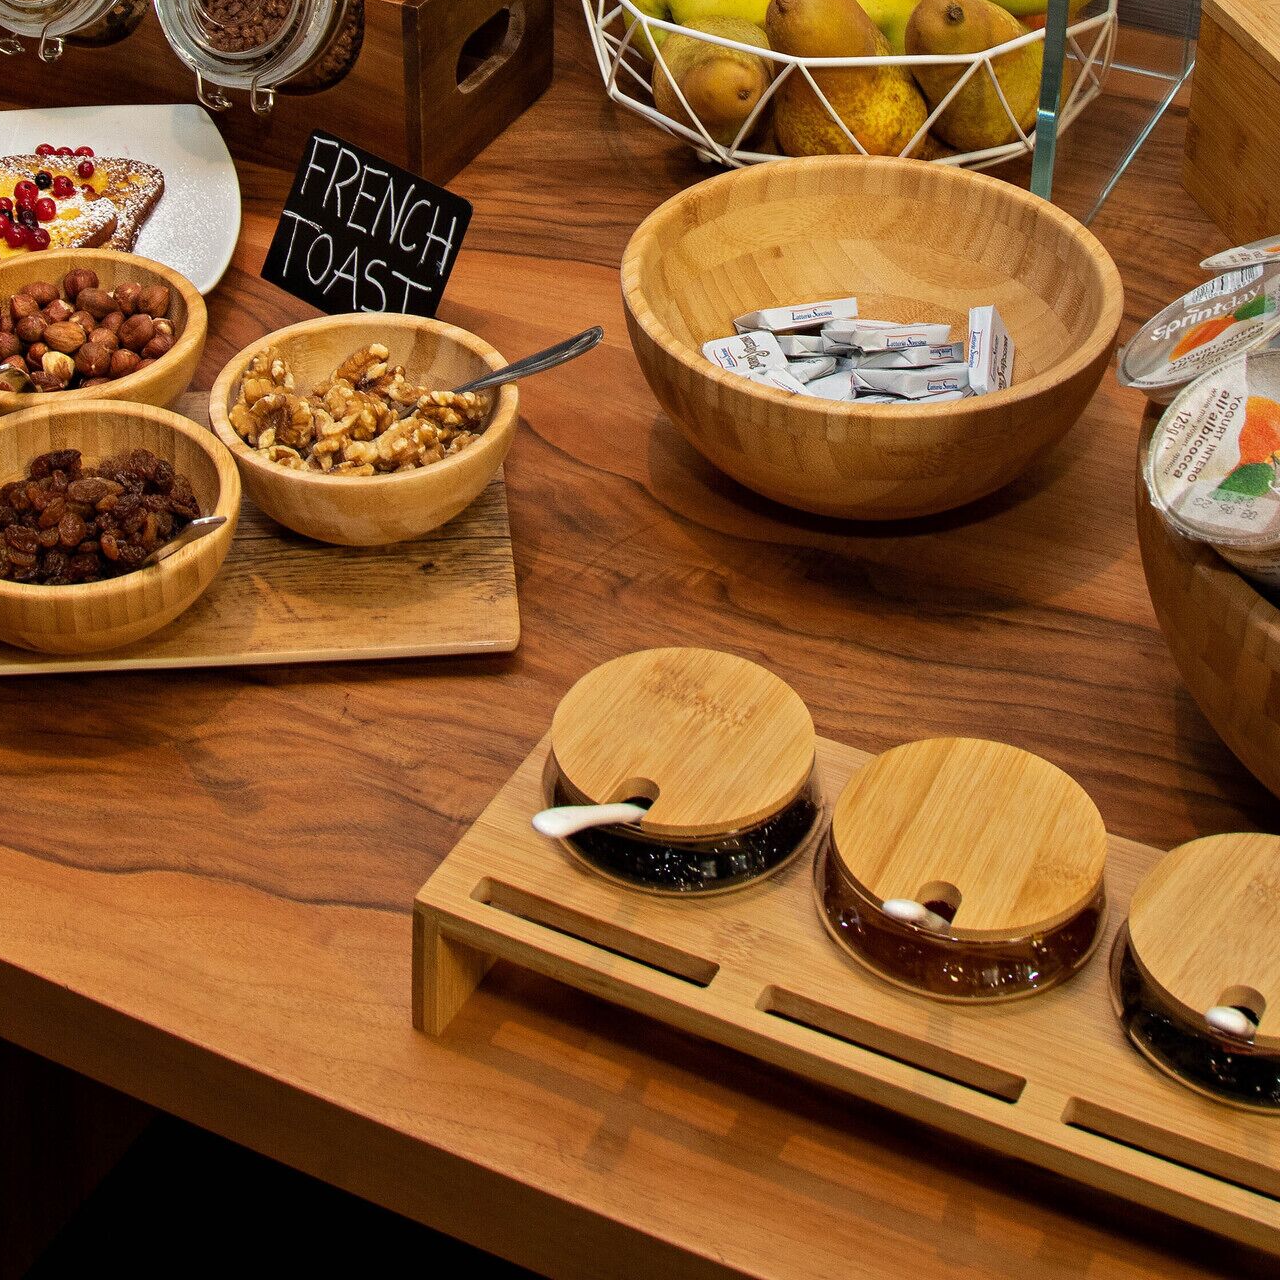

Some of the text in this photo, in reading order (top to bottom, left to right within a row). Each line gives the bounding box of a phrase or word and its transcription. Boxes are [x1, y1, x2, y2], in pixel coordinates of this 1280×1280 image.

[300, 136, 457, 276] FRENCH
[282, 209, 433, 314] TOAST
[1151, 284, 1261, 341] Sprintday
[1167, 410, 1192, 439] 125g
[1172, 390, 1231, 479] all'albicocca
[1187, 396, 1243, 483] YOGURT INTERO
